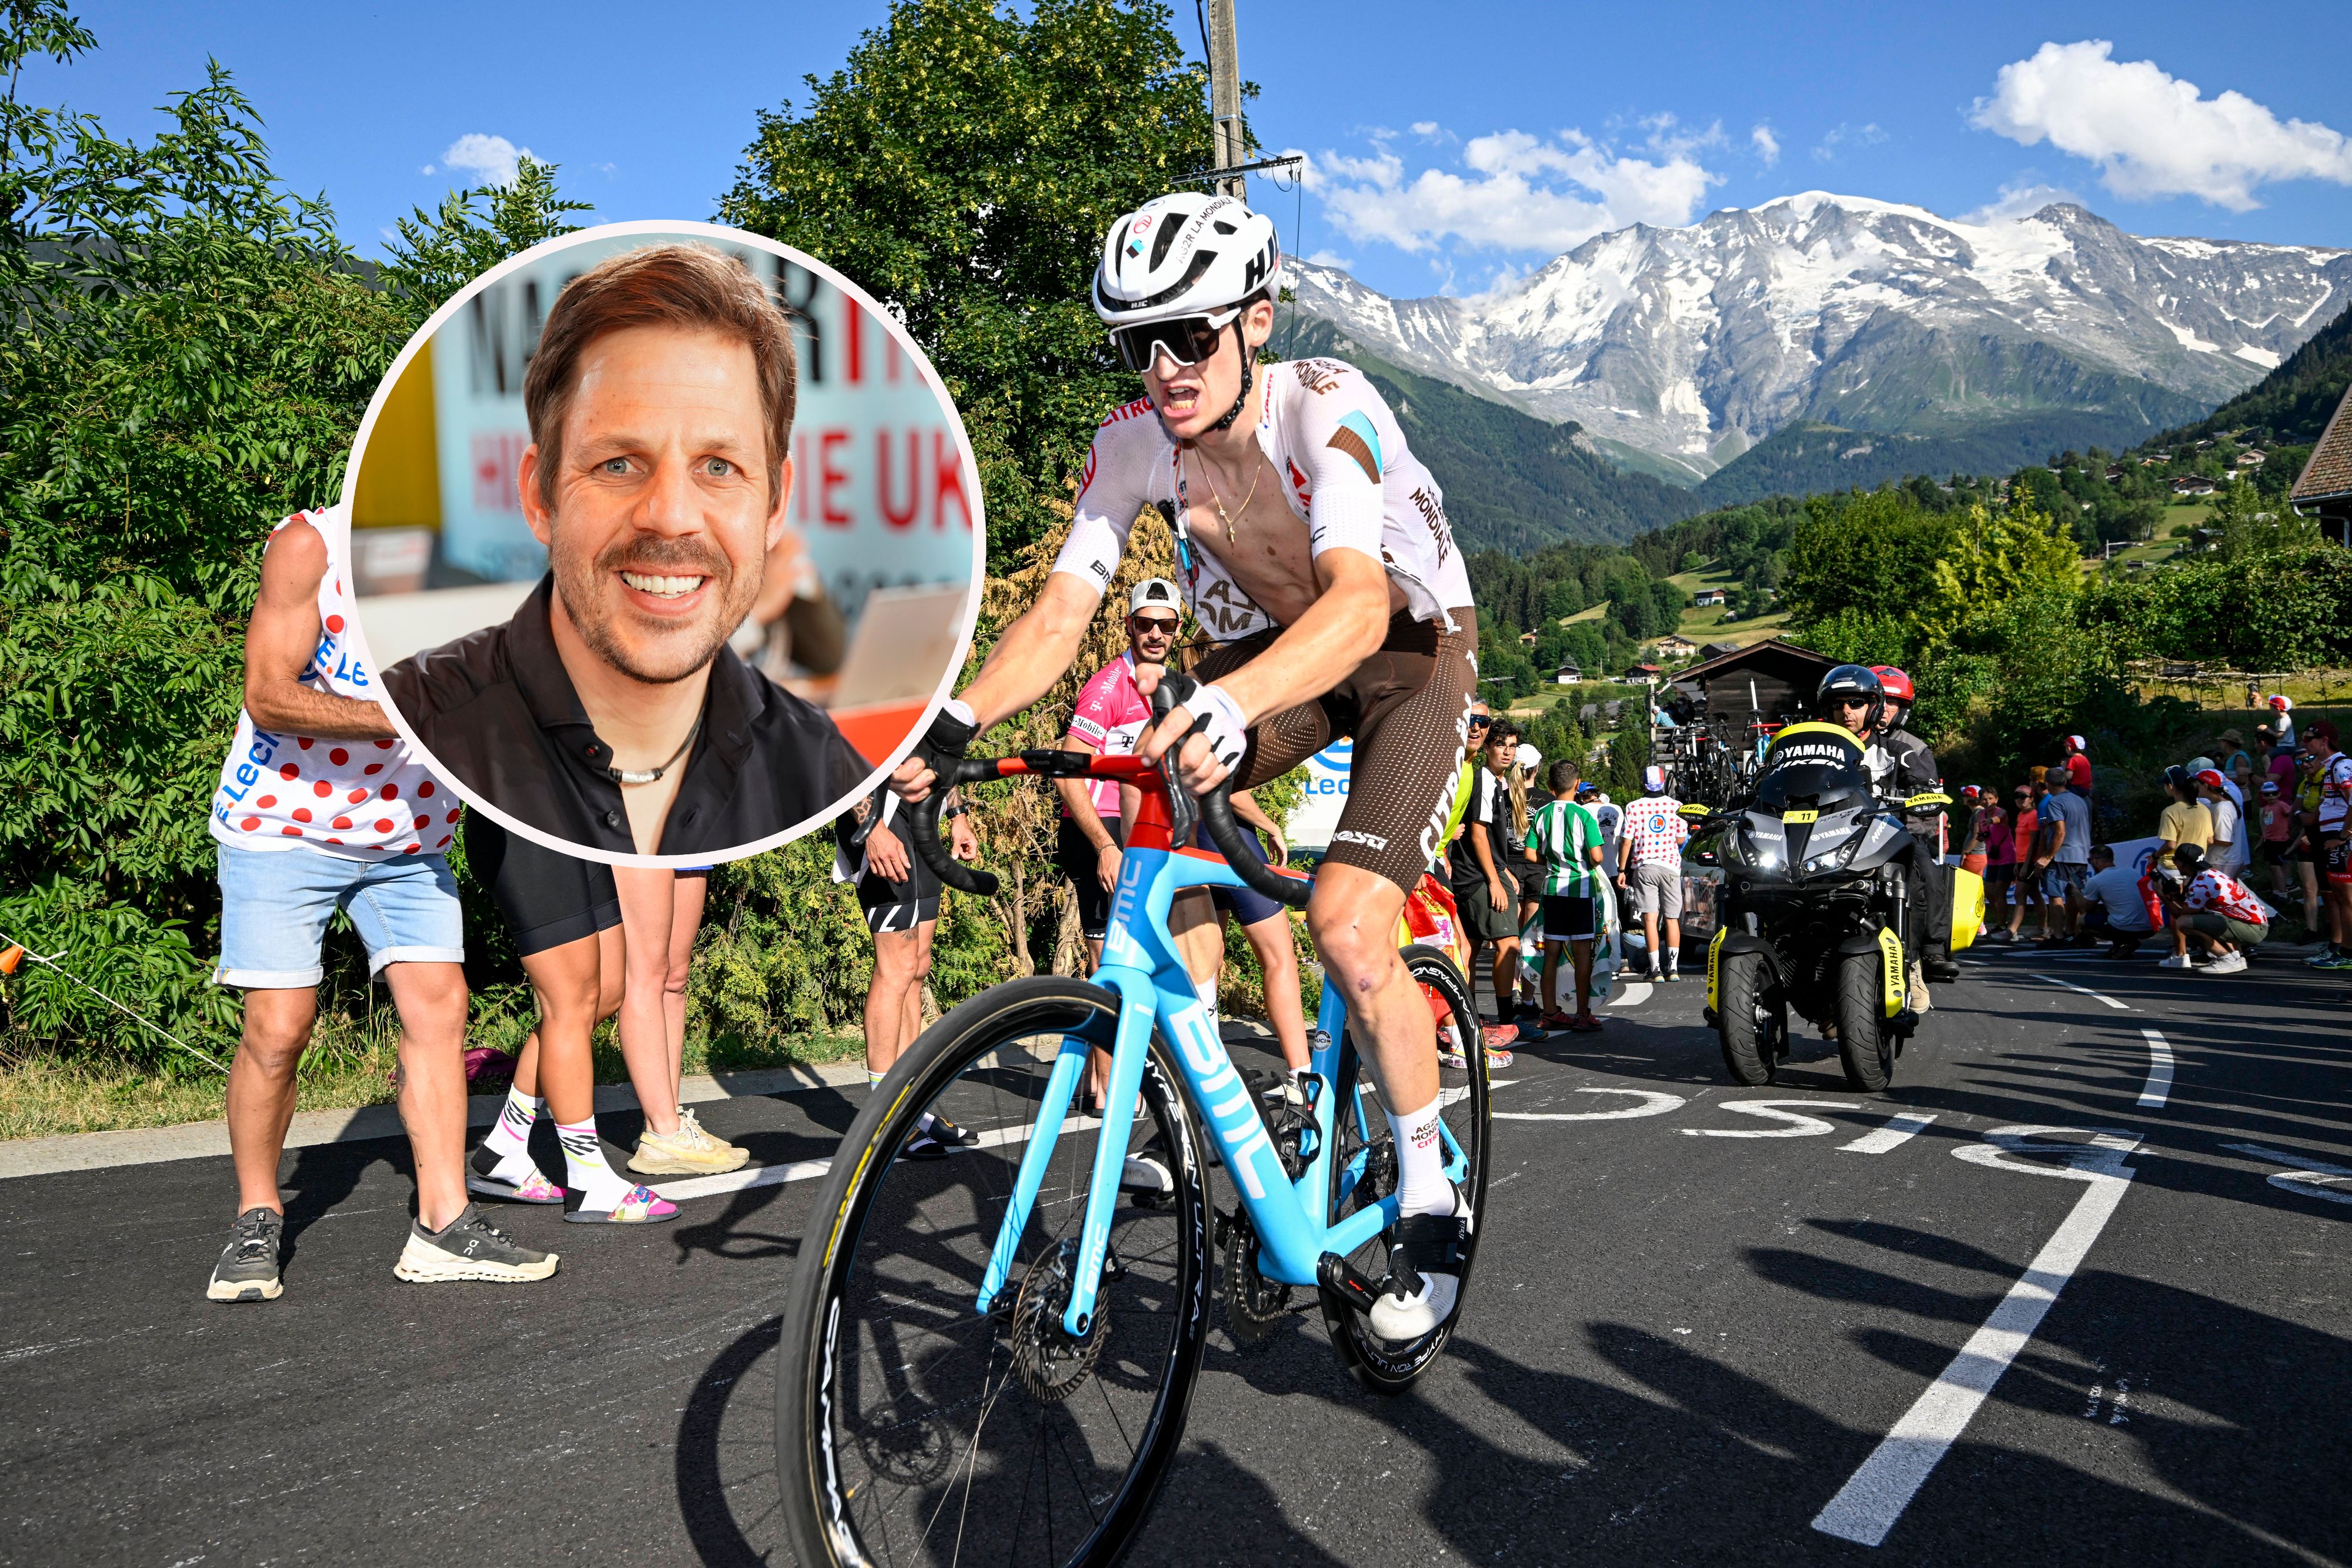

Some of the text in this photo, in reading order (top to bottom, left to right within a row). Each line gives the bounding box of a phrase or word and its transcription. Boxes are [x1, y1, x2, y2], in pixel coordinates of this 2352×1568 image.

[1191, 220, 1204, 233] LA
[1200, 197, 1233, 221] MONDIALE
[1131, 300, 1148, 309] HJC
[1409, 486, 1448, 570] MONDIALE
[1090, 559, 1111, 583] BM
[1785, 744, 1845, 762] YAMAHA
[1769, 758, 1845, 776] NIKEN
[1907, 795, 1943, 804] YAMAHA
[1800, 813, 1811, 821] 11
[1755, 831, 1783, 841] YAMAHA
[1819, 827, 1852, 840] YAMAHA
[1709, 945, 1717, 984] YAMAHA
[1890, 945, 1900, 987] YAMAHA
[1410, 966, 1475, 1029] CAMPAGNO
[1411, 1124, 1438, 1142] MOND
[1416, 1115, 1438, 1134] AG2R
[1084, 1222, 1108, 1295] BMC
[1191, 1201, 1203, 1323] ULTRA
[1390, 1328, 1444, 1373] HYPERON
